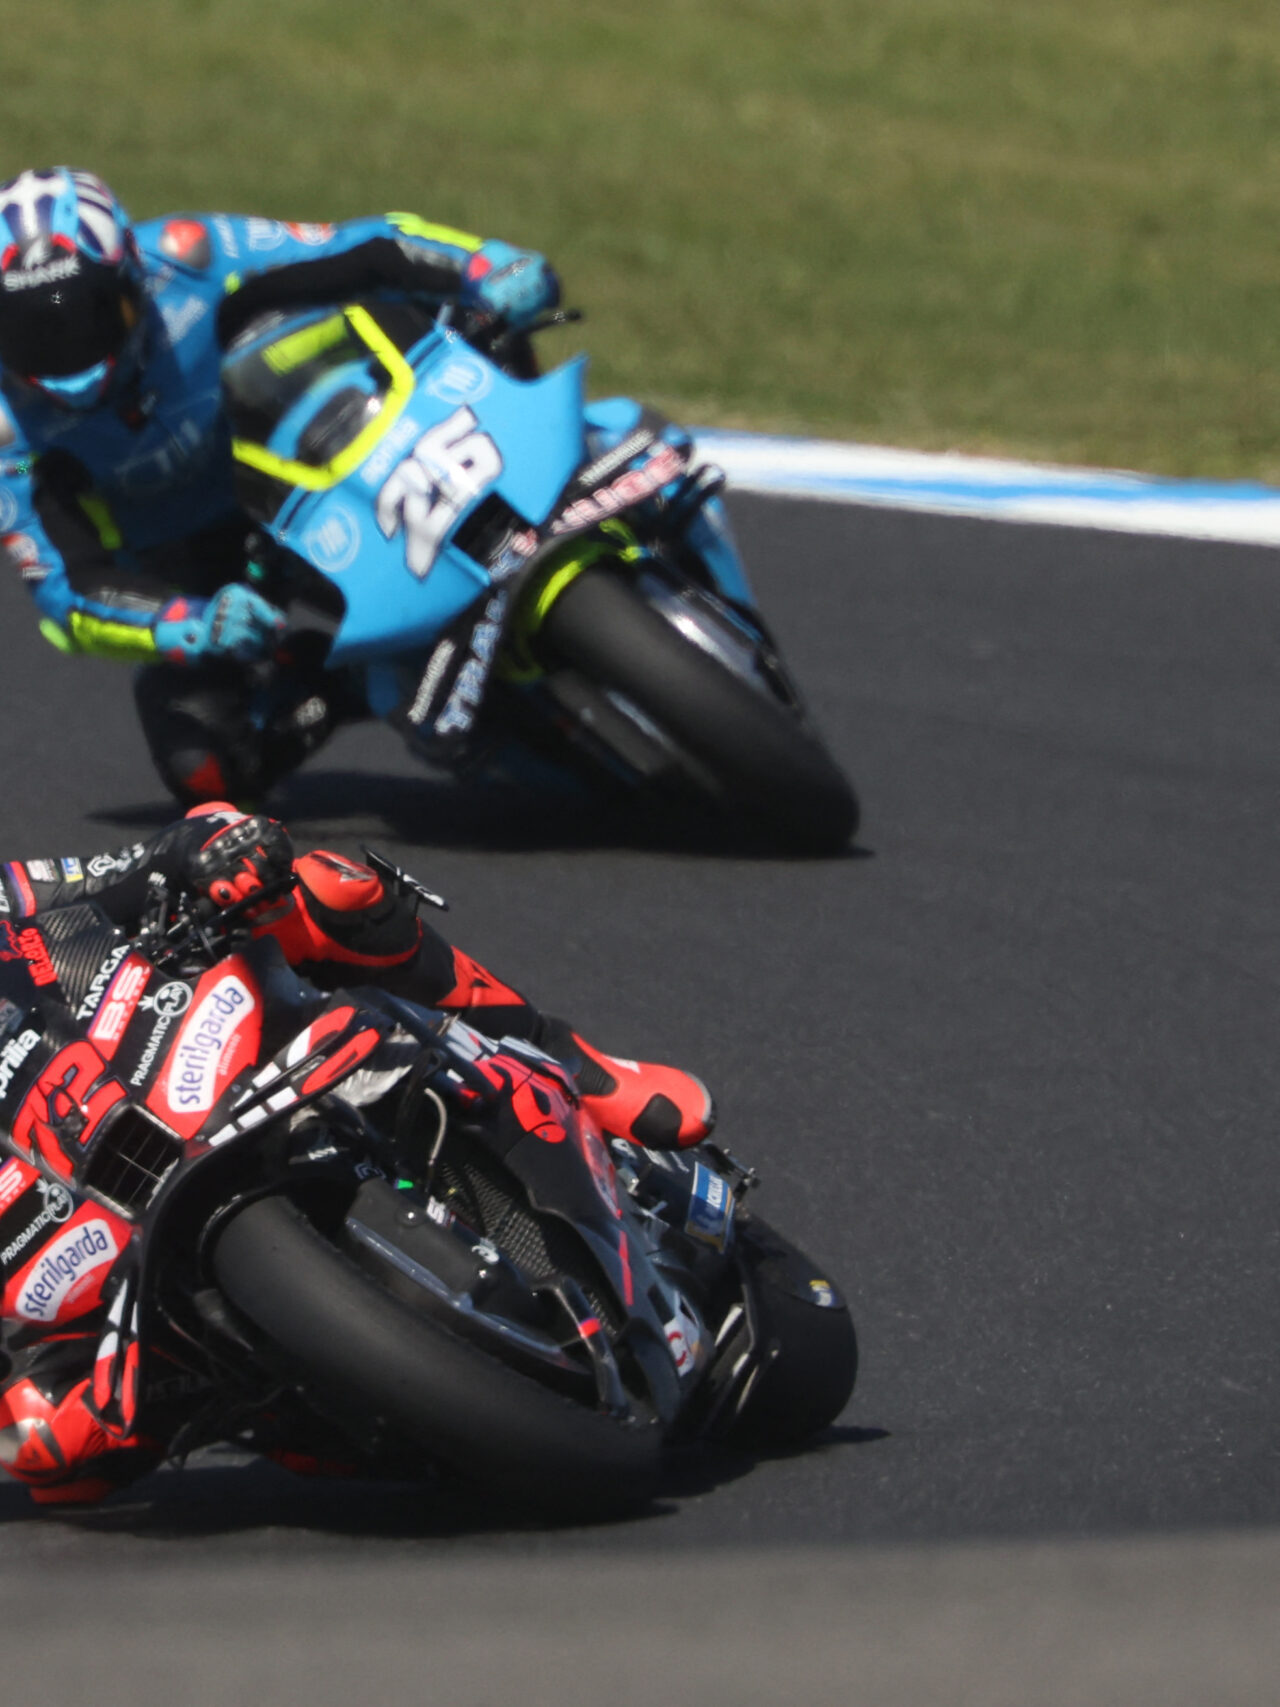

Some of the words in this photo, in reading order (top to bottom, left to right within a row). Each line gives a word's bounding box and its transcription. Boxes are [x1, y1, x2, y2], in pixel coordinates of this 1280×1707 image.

[3, 255, 80, 292] SHARK
[76, 945, 131, 1020] TARGA
[92, 963, 143, 1041] BS
[130, 1013, 171, 1087] PRAGMATIC
[164, 984, 184, 1016] PLAY
[176, 987, 245, 1106] sterilgarda
[10, 1041, 128, 1180] 72
[0, 1213, 51, 1265] PRAGMATIC
[24, 1226, 109, 1317] sterilgarda
